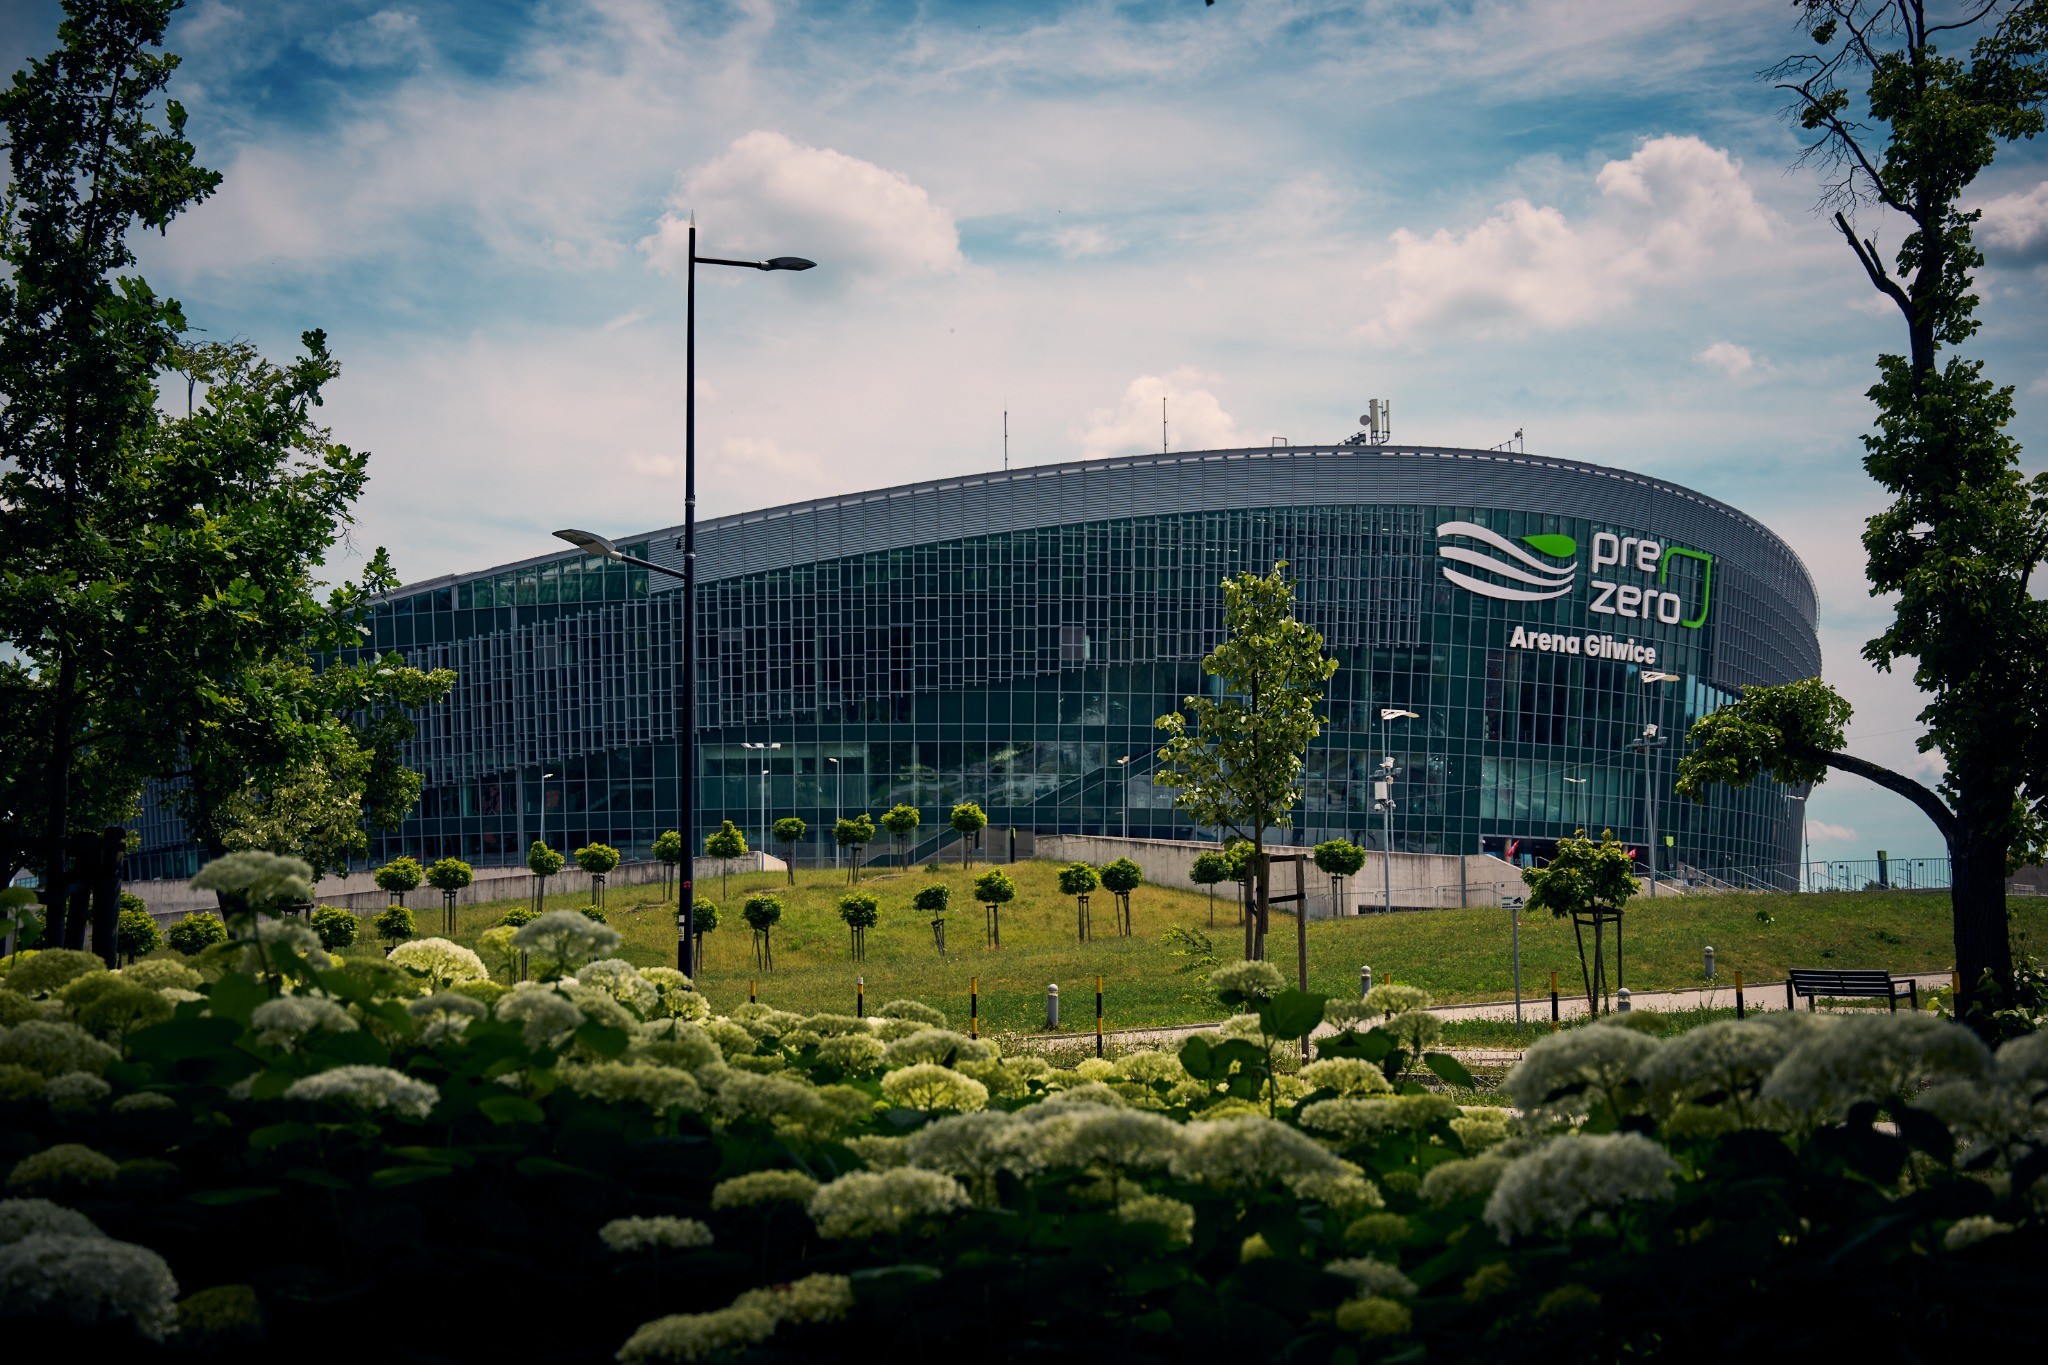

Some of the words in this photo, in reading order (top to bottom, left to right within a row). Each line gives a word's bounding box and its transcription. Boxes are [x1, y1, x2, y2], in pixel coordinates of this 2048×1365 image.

[1591, 532, 1661, 573] pre
[1589, 580, 1681, 625] zero
[1509, 625, 1580, 655] Arena
[1584, 634, 1656, 665] Gliwice
